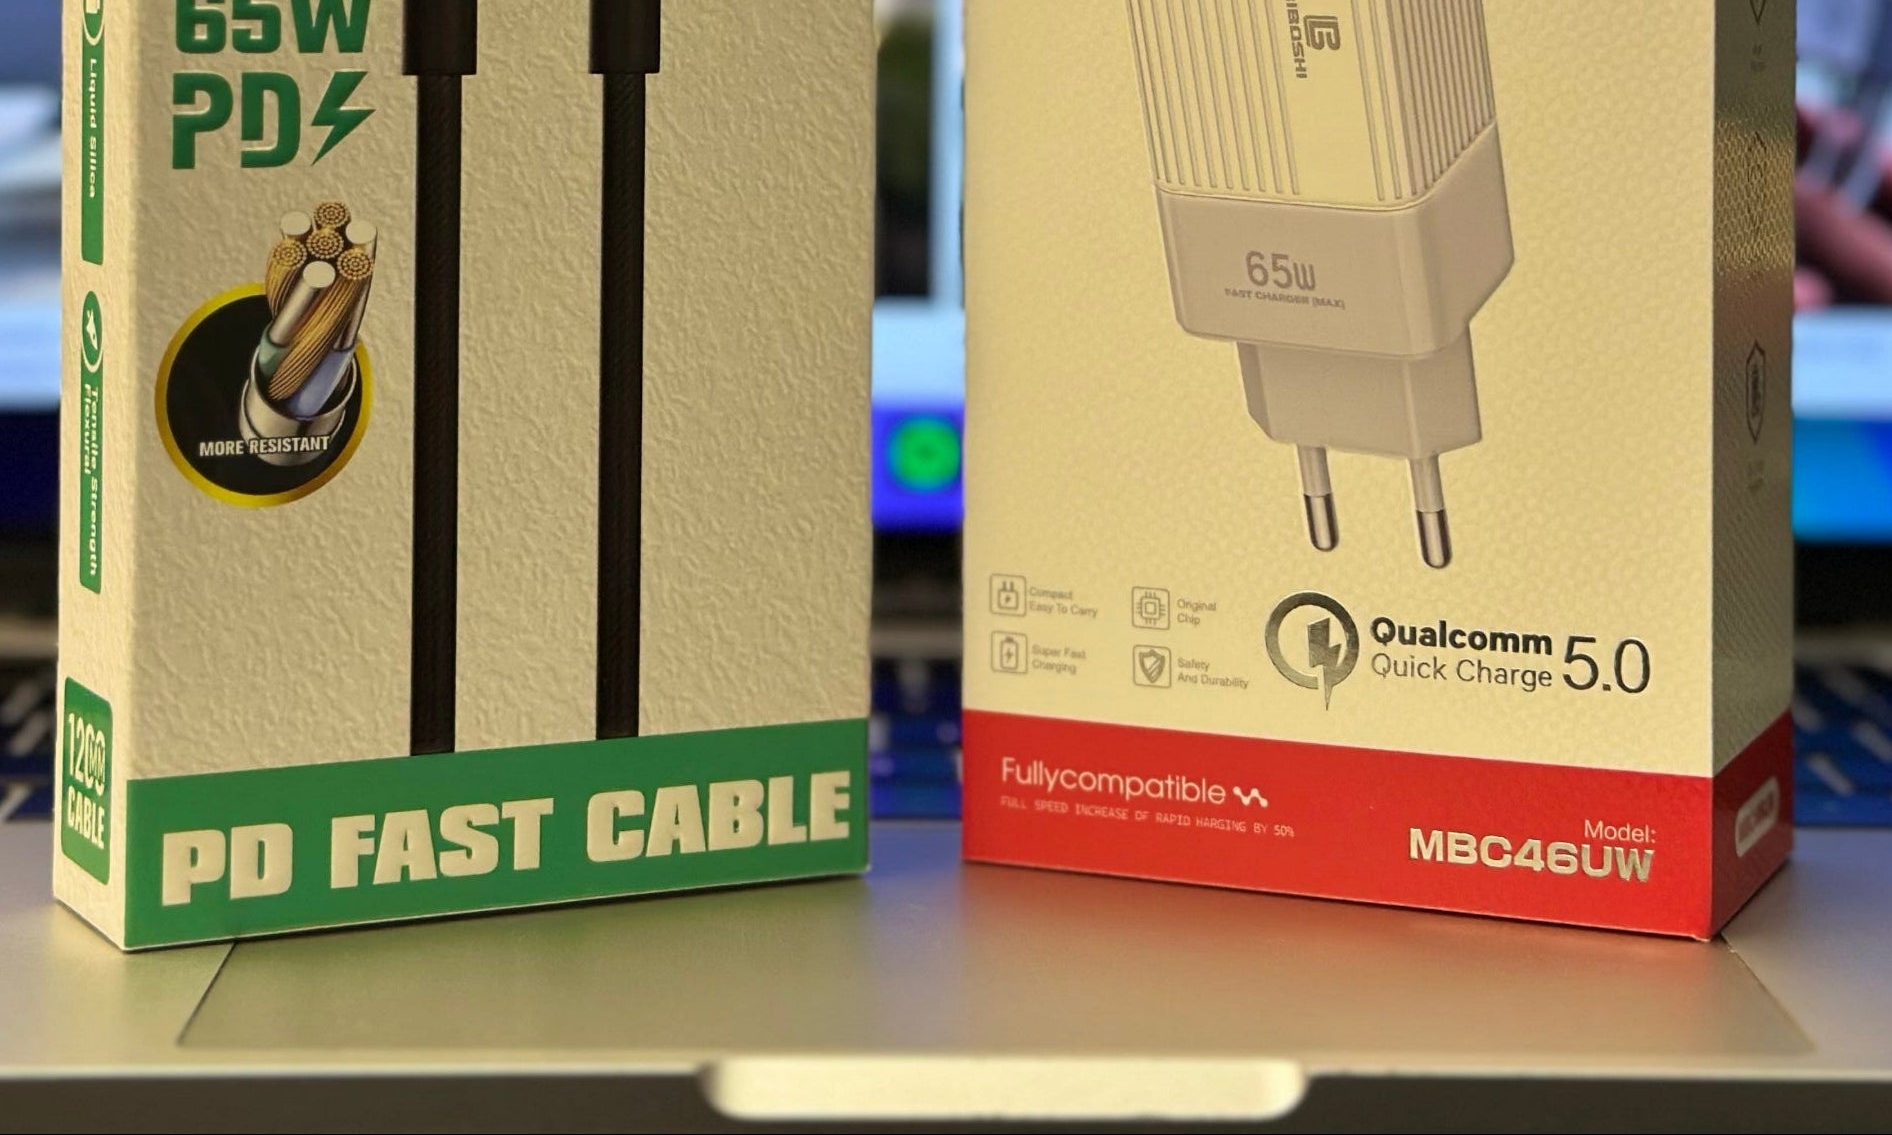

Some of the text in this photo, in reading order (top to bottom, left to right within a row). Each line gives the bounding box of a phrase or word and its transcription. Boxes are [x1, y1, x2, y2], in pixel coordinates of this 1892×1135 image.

[89, 58, 97, 198] Liquid Silica
[172, 71, 301, 170] PD
[199, 435, 330, 457] MORE RESISTANT
[89, 386, 99, 576] Tensile Strength
[1070, 604, 1098, 618] Carry
[1177, 598, 1217, 612] Original
[1177, 612, 1201, 627] Chip
[1370, 616, 1552, 656] Qualcomm
[1178, 657, 1210, 672] Safety
[1178, 672, 1249, 689] And Durability
[1370, 652, 1552, 692] Quick Charge
[1563, 635, 1652, 694] 5.0
[1002, 757, 1226, 805] Fullycompatible
[67, 785, 105, 850] CABLE
[1000, 795, 1295, 838] FULL SPEED INCREASE OF RAPID HARGING BY 50%
[1584, 819, 1656, 844] Model:
[162, 769, 851, 907] PD FAST CABLE
[1409, 827, 1655, 883] MBC46UW
